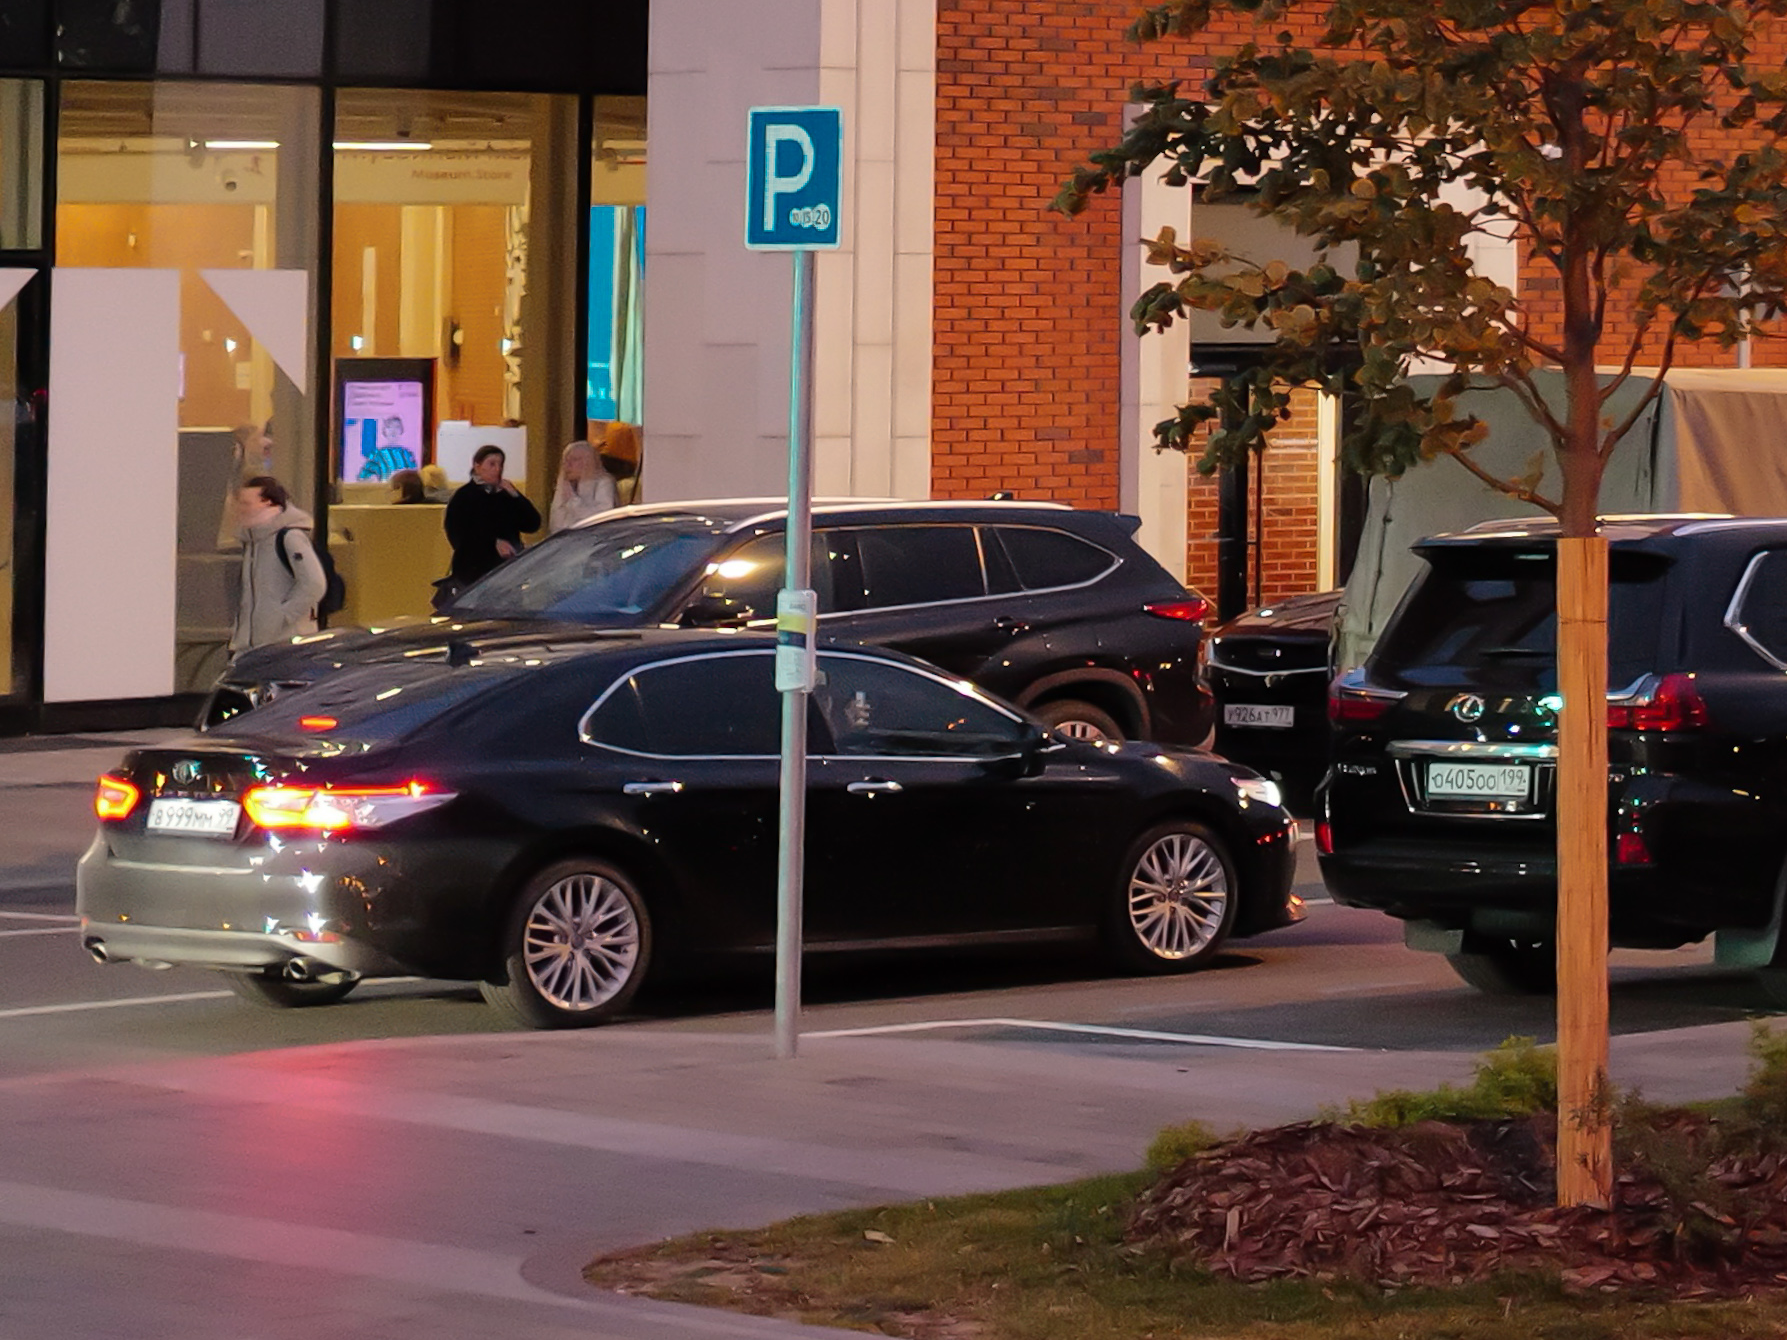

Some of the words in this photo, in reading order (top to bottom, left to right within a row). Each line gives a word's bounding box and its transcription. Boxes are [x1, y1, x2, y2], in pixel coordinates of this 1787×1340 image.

[764, 124, 815, 232] P
[815, 209, 830, 225] 20
[1500, 768, 1524, 786] 199
